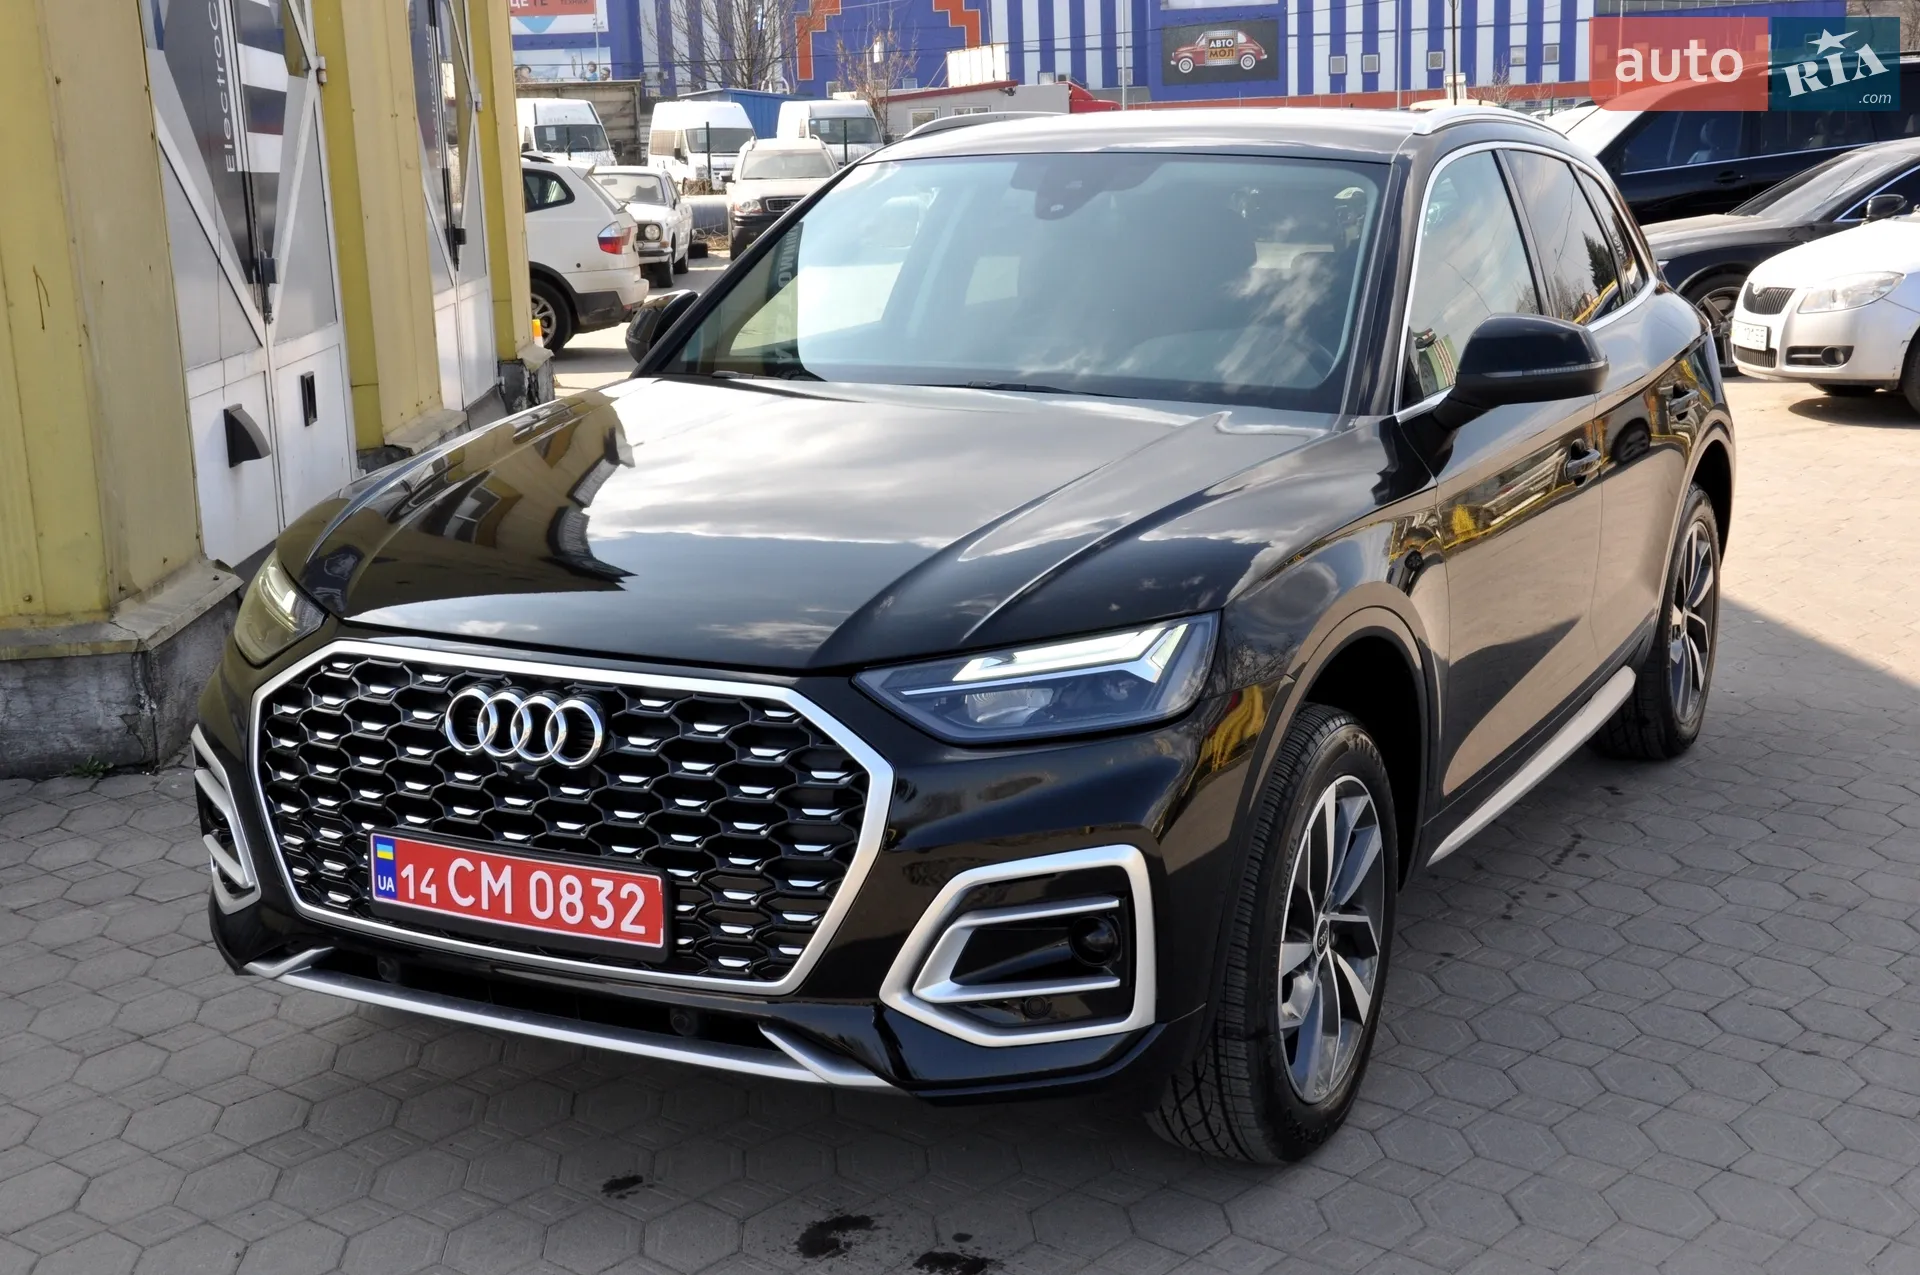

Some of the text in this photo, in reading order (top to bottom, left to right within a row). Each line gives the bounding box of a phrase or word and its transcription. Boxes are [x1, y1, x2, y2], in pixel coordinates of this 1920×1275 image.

[1209, 39, 1234, 48] АВТО
[1209, 48, 1234, 58] МОЛ
[378, 875, 395, 892] UA
[400, 858, 646, 935] 14 CM 0832
